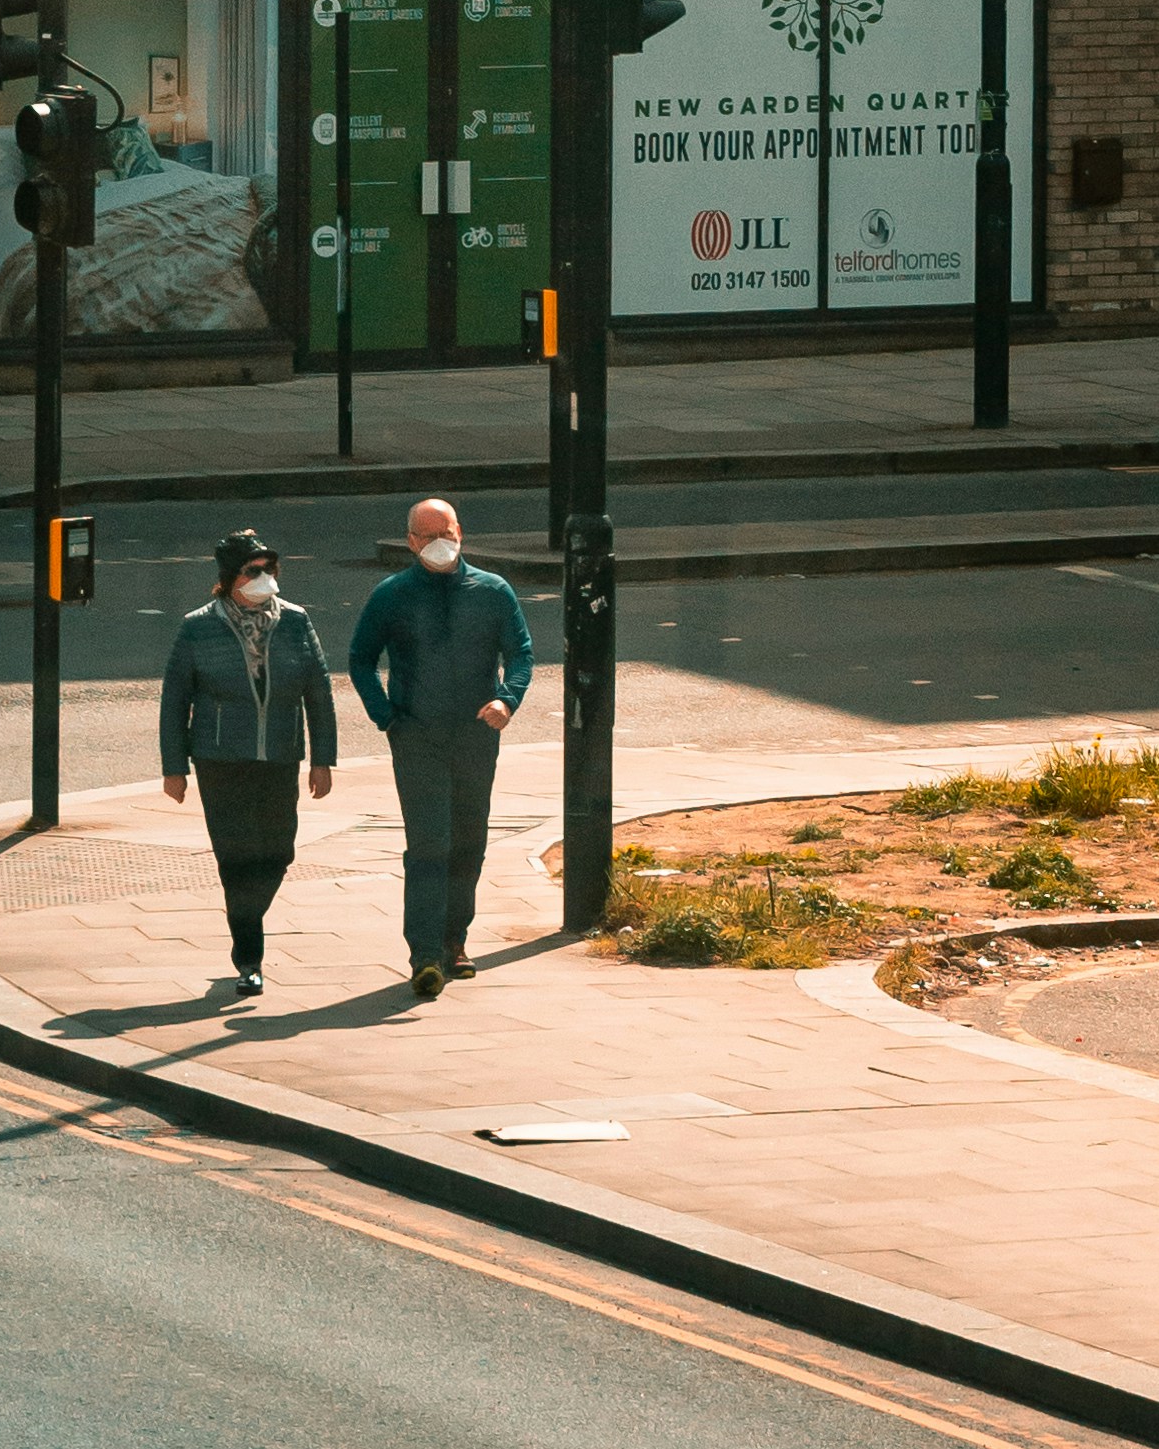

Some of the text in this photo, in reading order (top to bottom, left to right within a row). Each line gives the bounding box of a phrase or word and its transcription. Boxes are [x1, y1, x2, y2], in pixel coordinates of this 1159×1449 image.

[634, 90, 1010, 118] NEW GARDEN QUART
[349, 114, 382, 127] XCELLENT
[349, 127, 384, 140] RANSPORT
[634, 132, 690, 164] BOOK
[699, 130, 755, 162] YOUR
[937, 124, 977, 155] TOD
[734, 217, 791, 250] JLL
[834, 249, 961, 272] telfordhomes
[691, 269, 811, 291] 020 3147 1500
